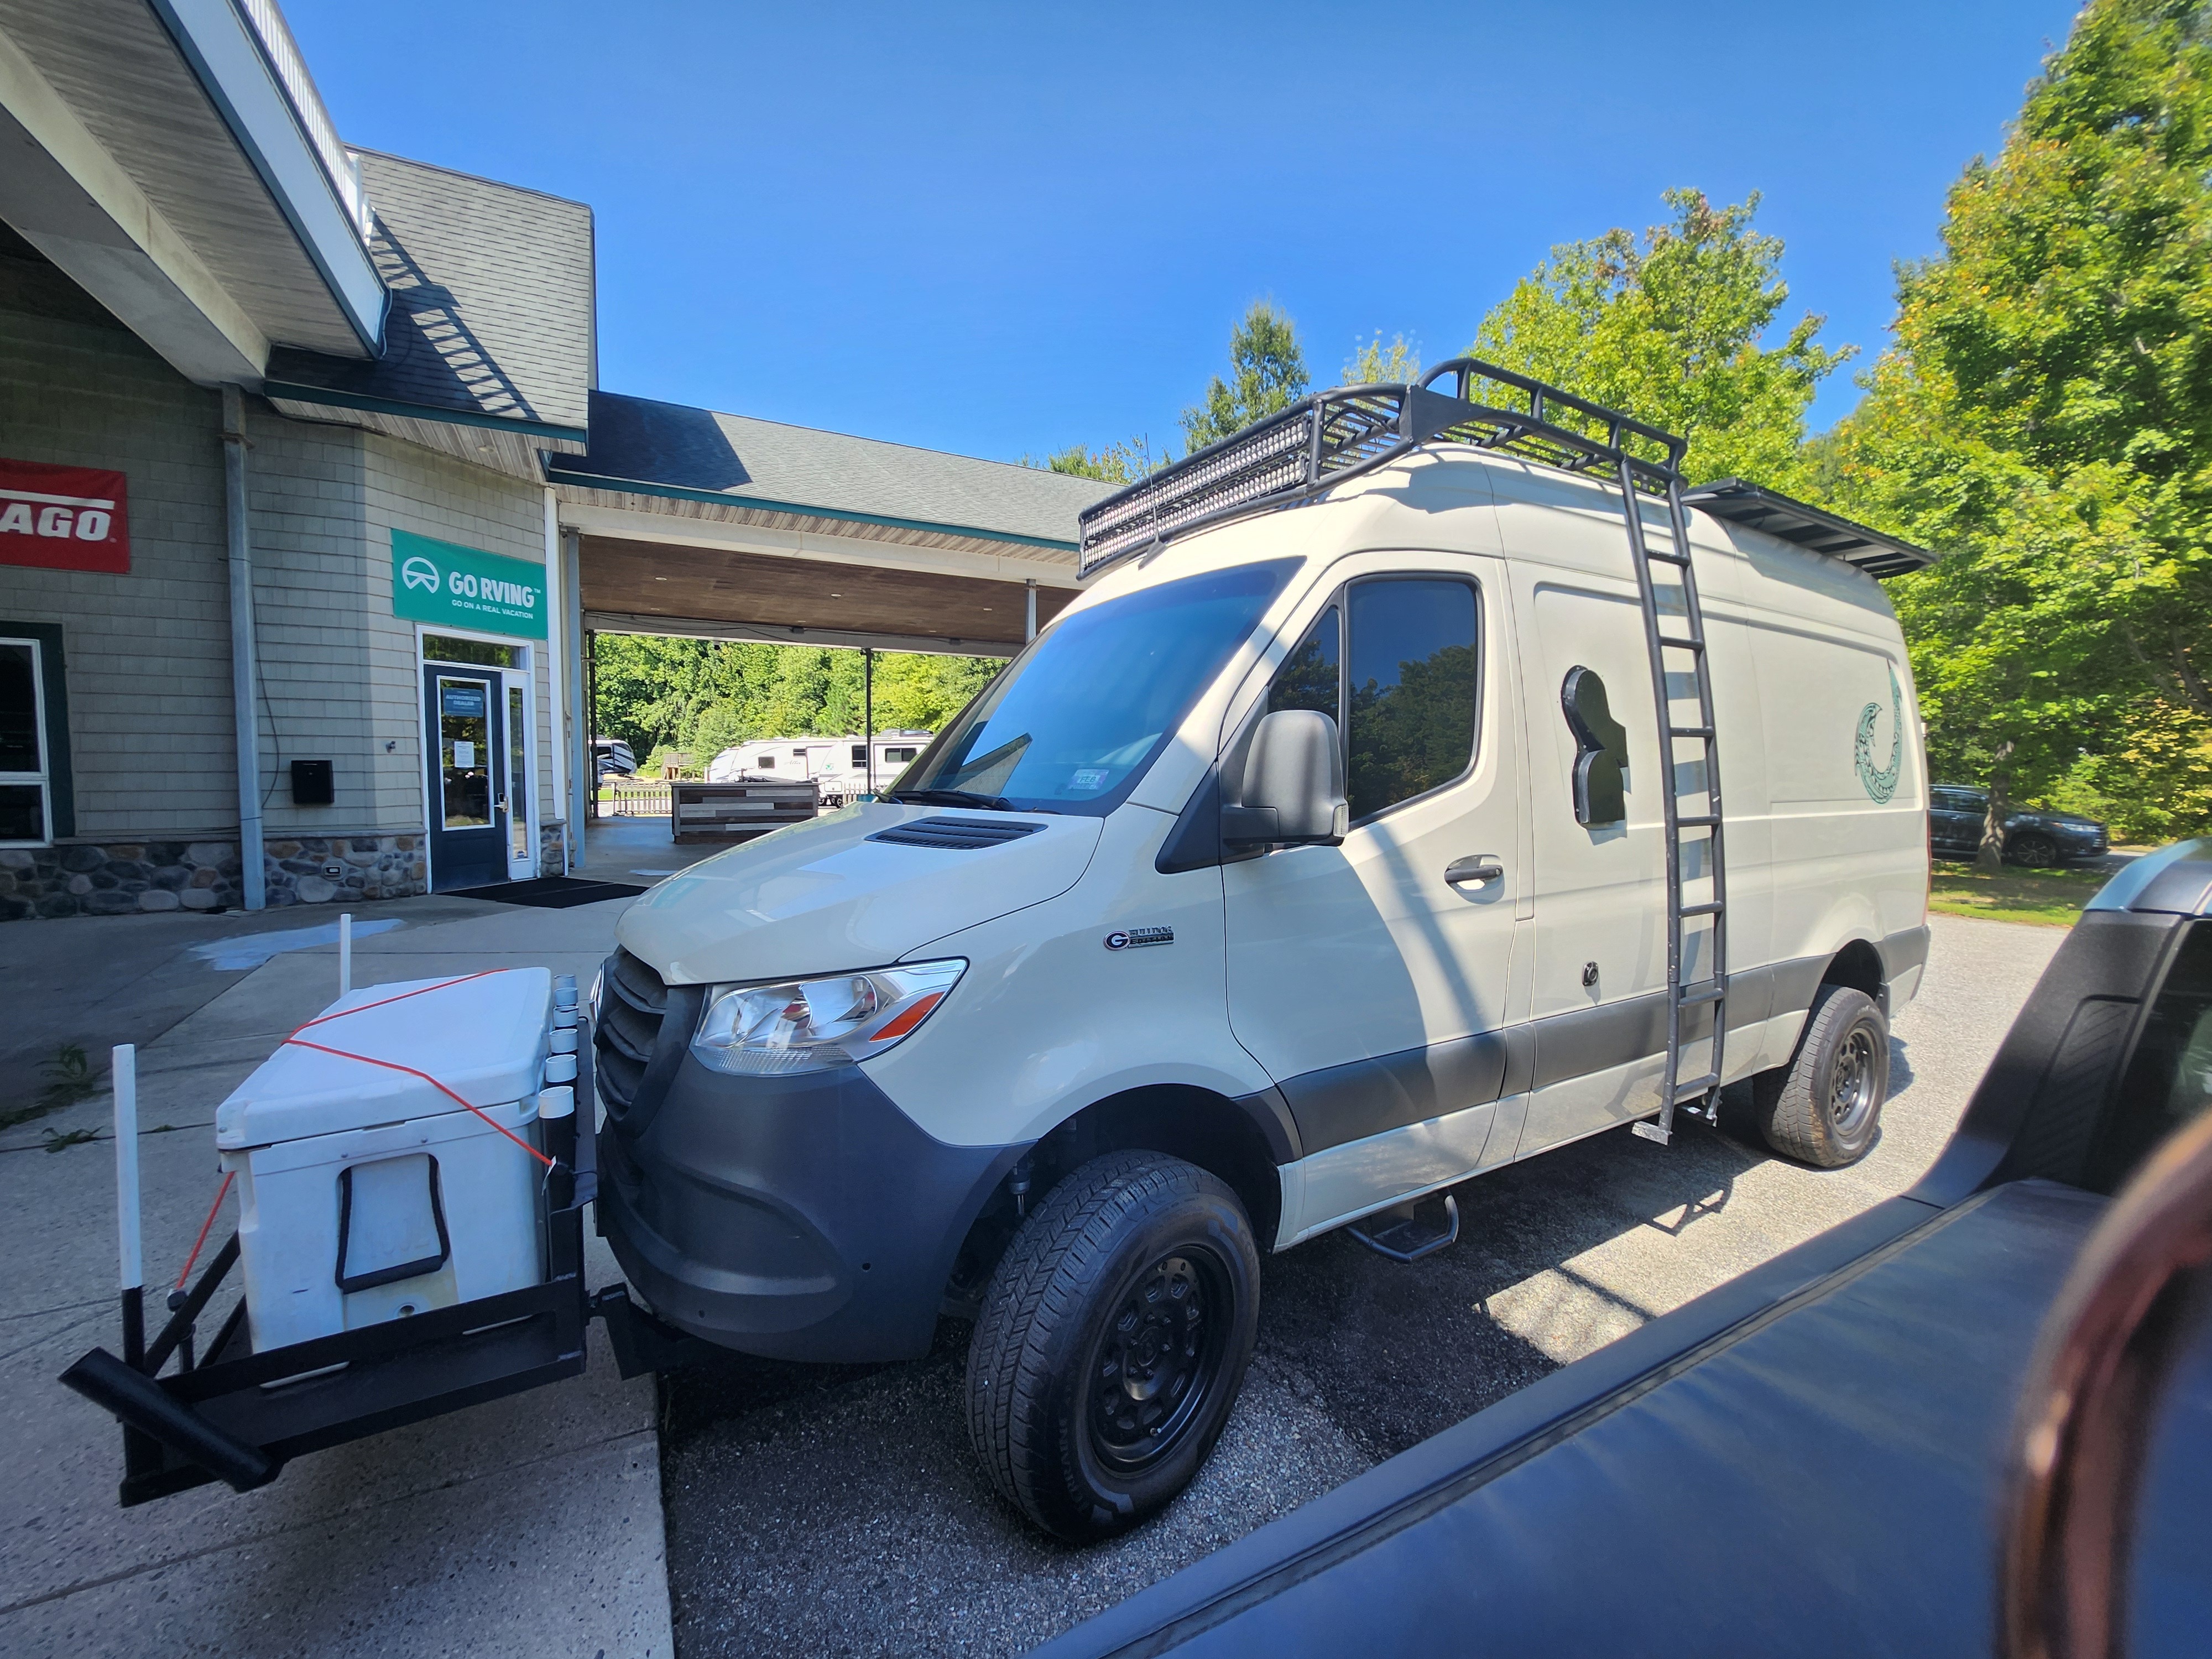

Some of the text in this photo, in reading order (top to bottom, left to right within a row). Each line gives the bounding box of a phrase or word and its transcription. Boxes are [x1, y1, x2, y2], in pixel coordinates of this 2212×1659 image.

[449, 572, 477, 597] GO
[482, 605, 500, 614] REAL
[502, 609, 533, 619] VACATION
